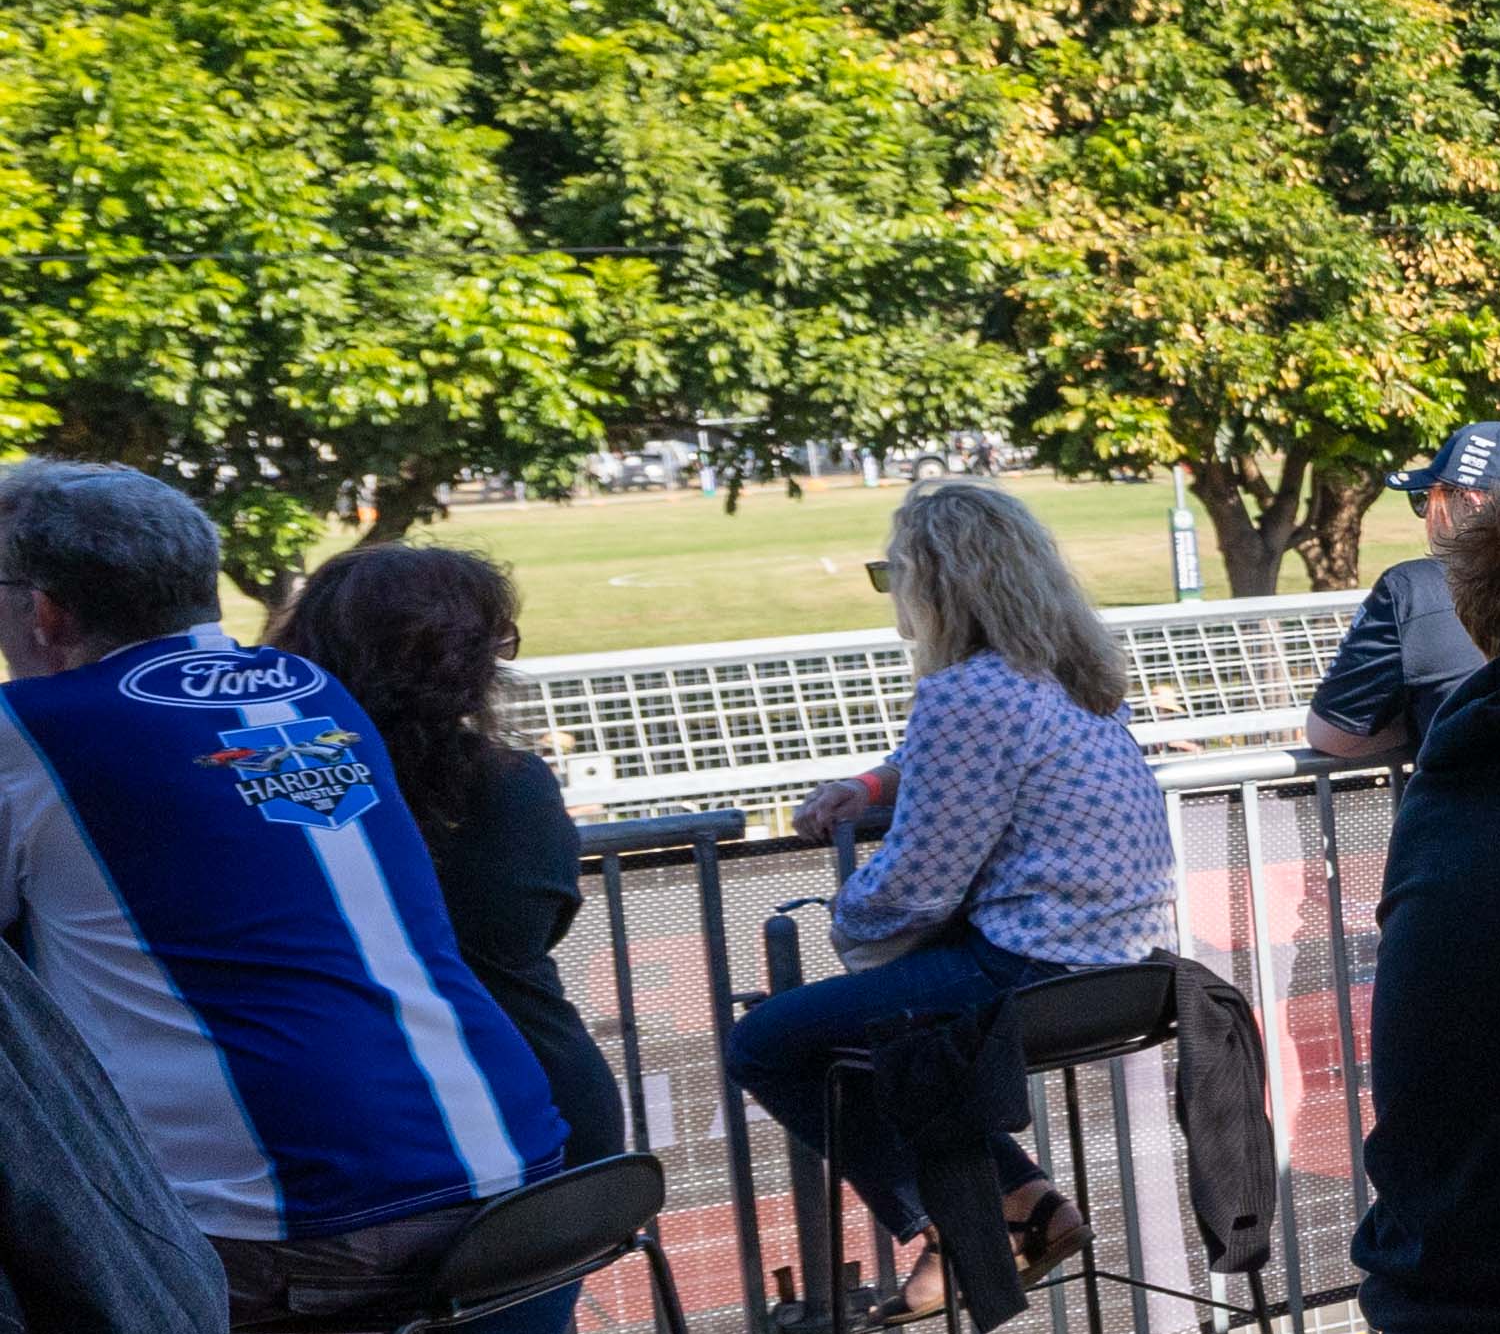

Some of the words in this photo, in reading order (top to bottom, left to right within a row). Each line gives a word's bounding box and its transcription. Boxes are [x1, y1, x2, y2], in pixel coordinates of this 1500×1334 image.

[181, 657, 297, 698] Ford
[235, 763, 371, 806] HARDTOP
[290, 784, 347, 803] HUSTLE
